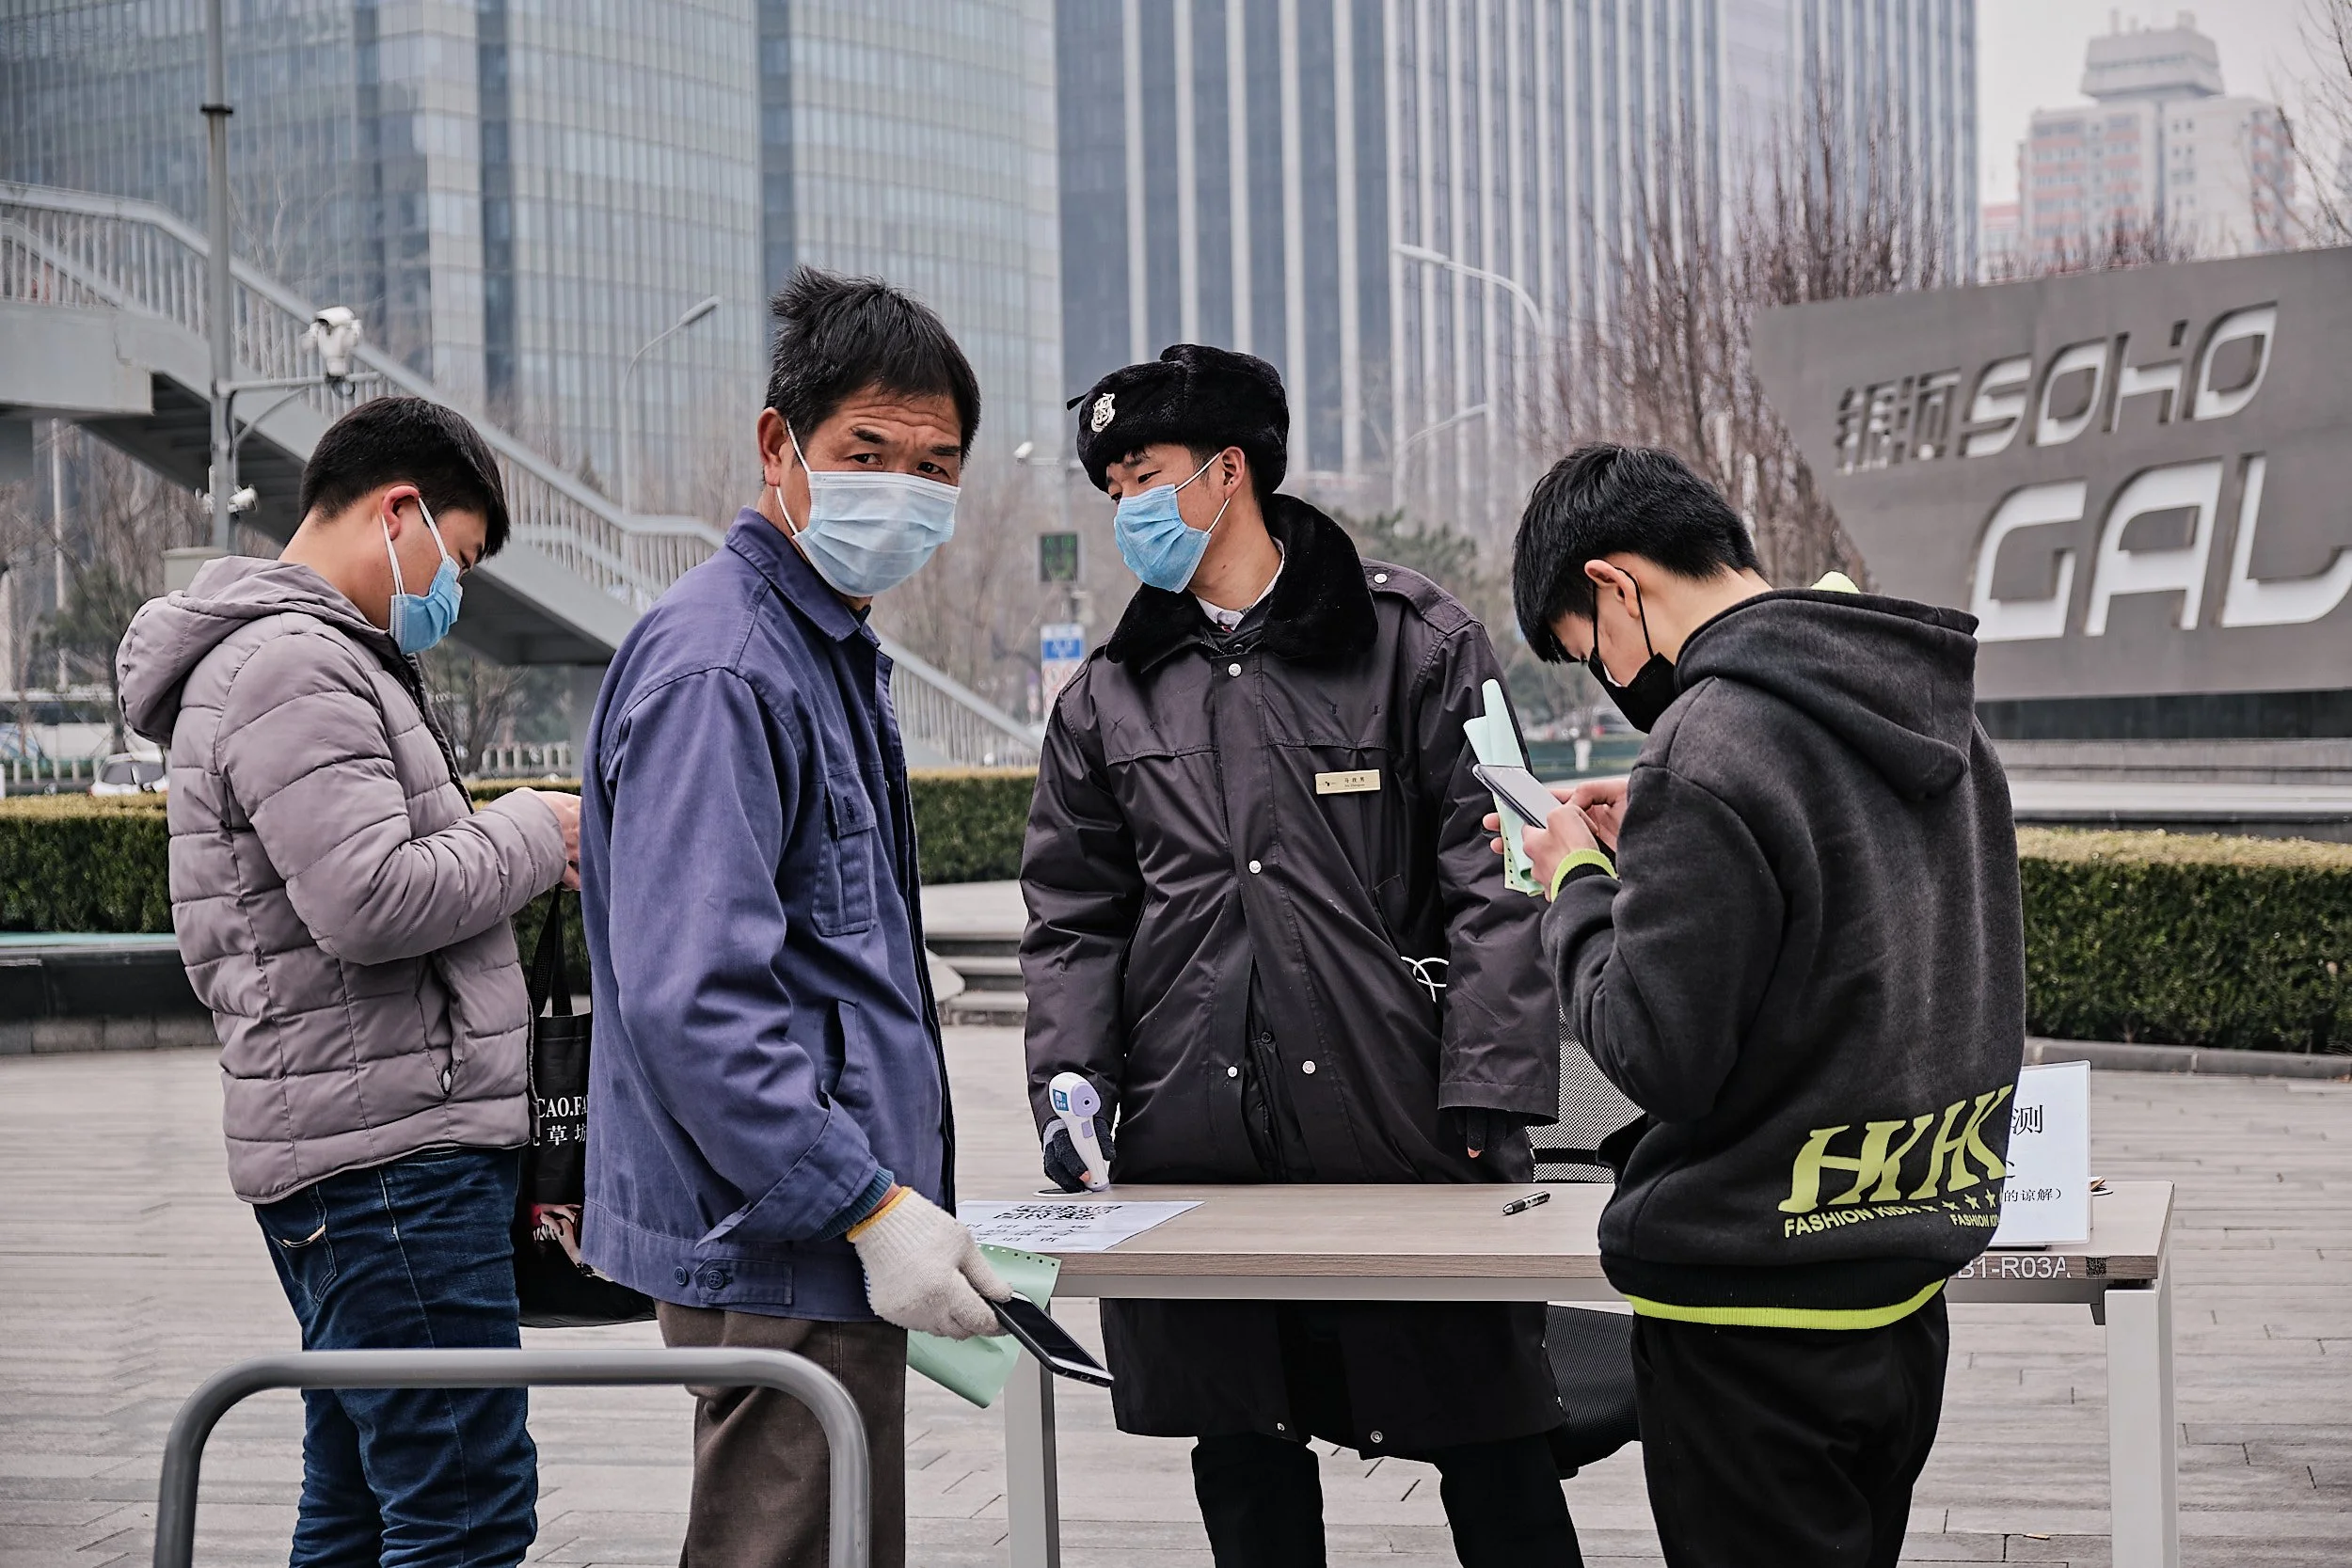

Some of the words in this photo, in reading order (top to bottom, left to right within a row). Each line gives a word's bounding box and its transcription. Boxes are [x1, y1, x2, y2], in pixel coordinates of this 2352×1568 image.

[1969, 451, 2352, 643] GAL
[537, 1094, 588, 1118] CAO.FA
[2011, 1104, 2043, 1136] 测
[533, 1123, 587, 1147] 草坊
[1784, 1208, 1875, 1239] FASHION
[1948, 1213, 1990, 1228] FASHION
